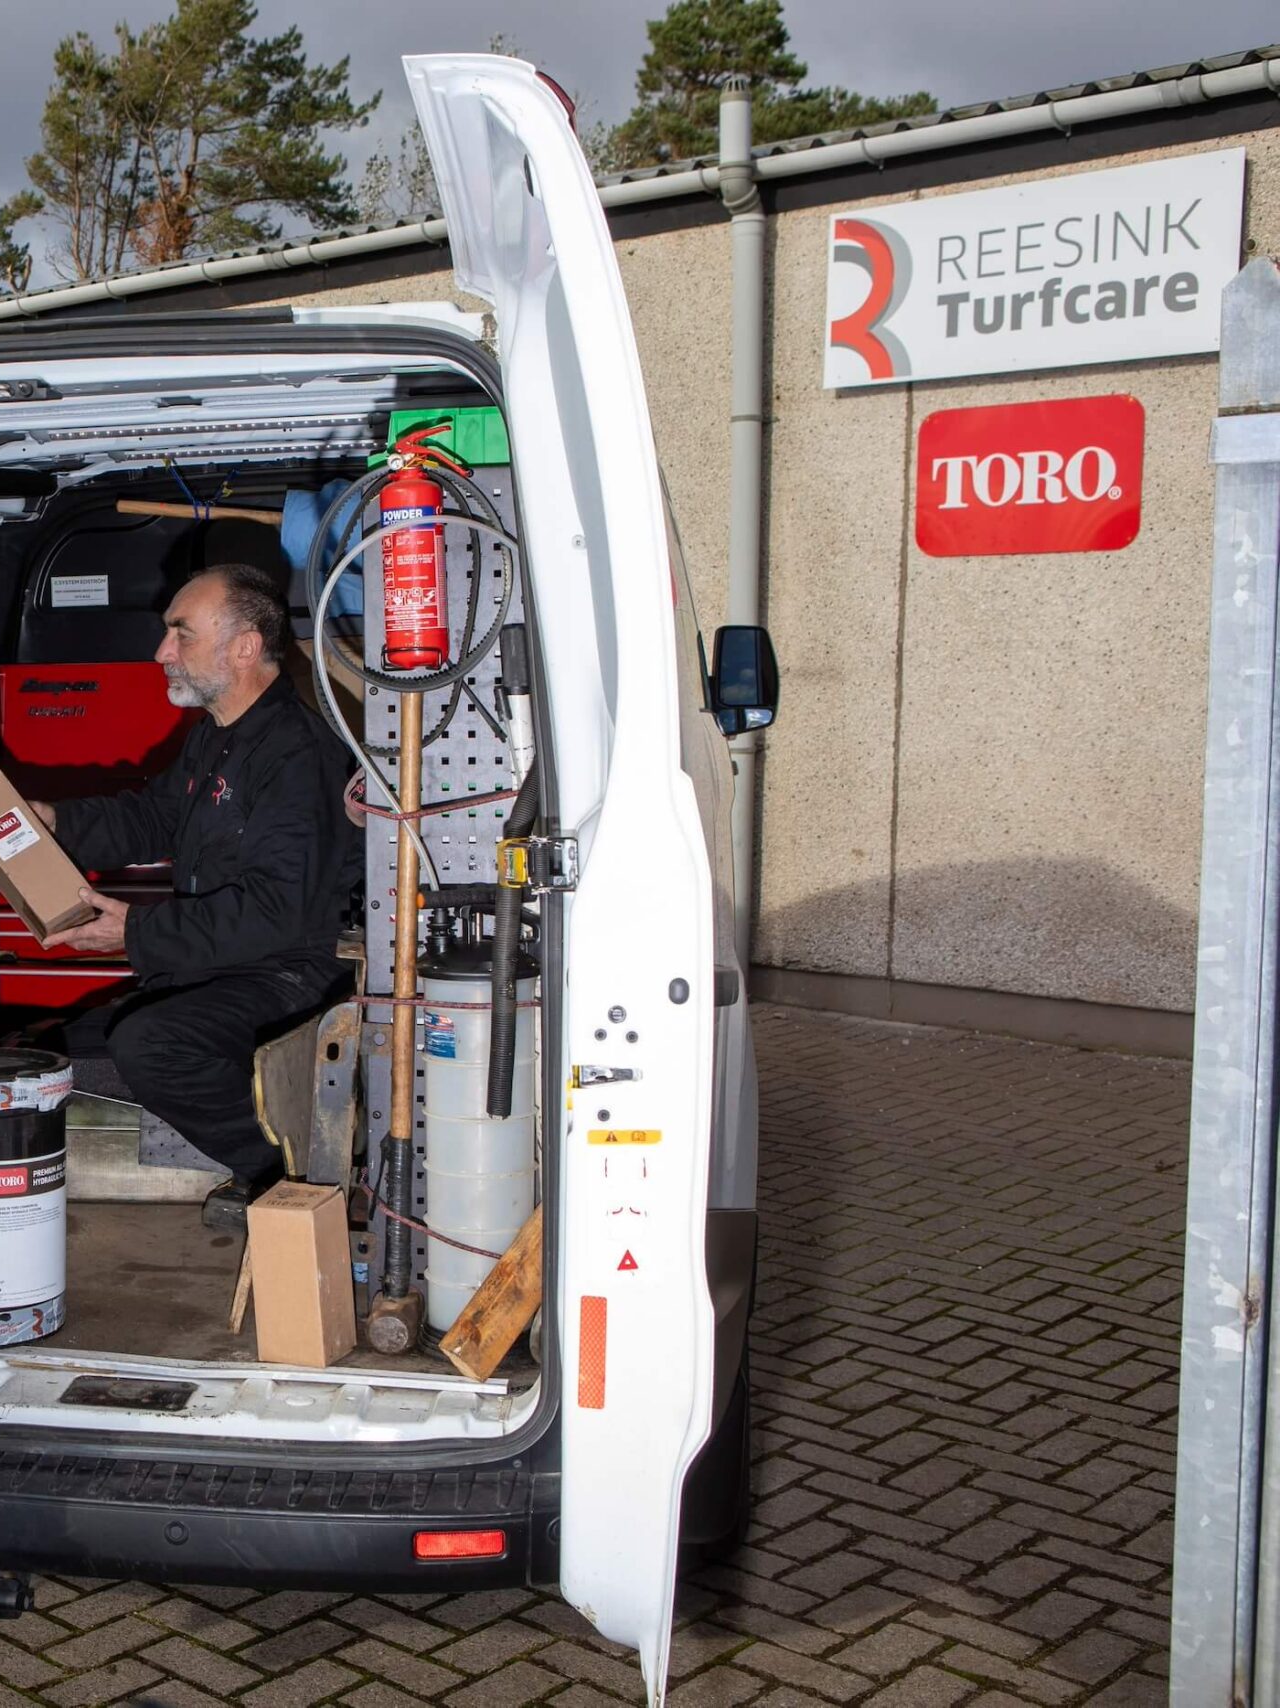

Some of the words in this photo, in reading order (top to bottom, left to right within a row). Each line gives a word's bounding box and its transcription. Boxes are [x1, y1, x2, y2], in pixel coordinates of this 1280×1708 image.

[936, 198, 1203, 285] REESINK
[936, 270, 1200, 338] Turfcare
[383, 508, 423, 522] POWDER
